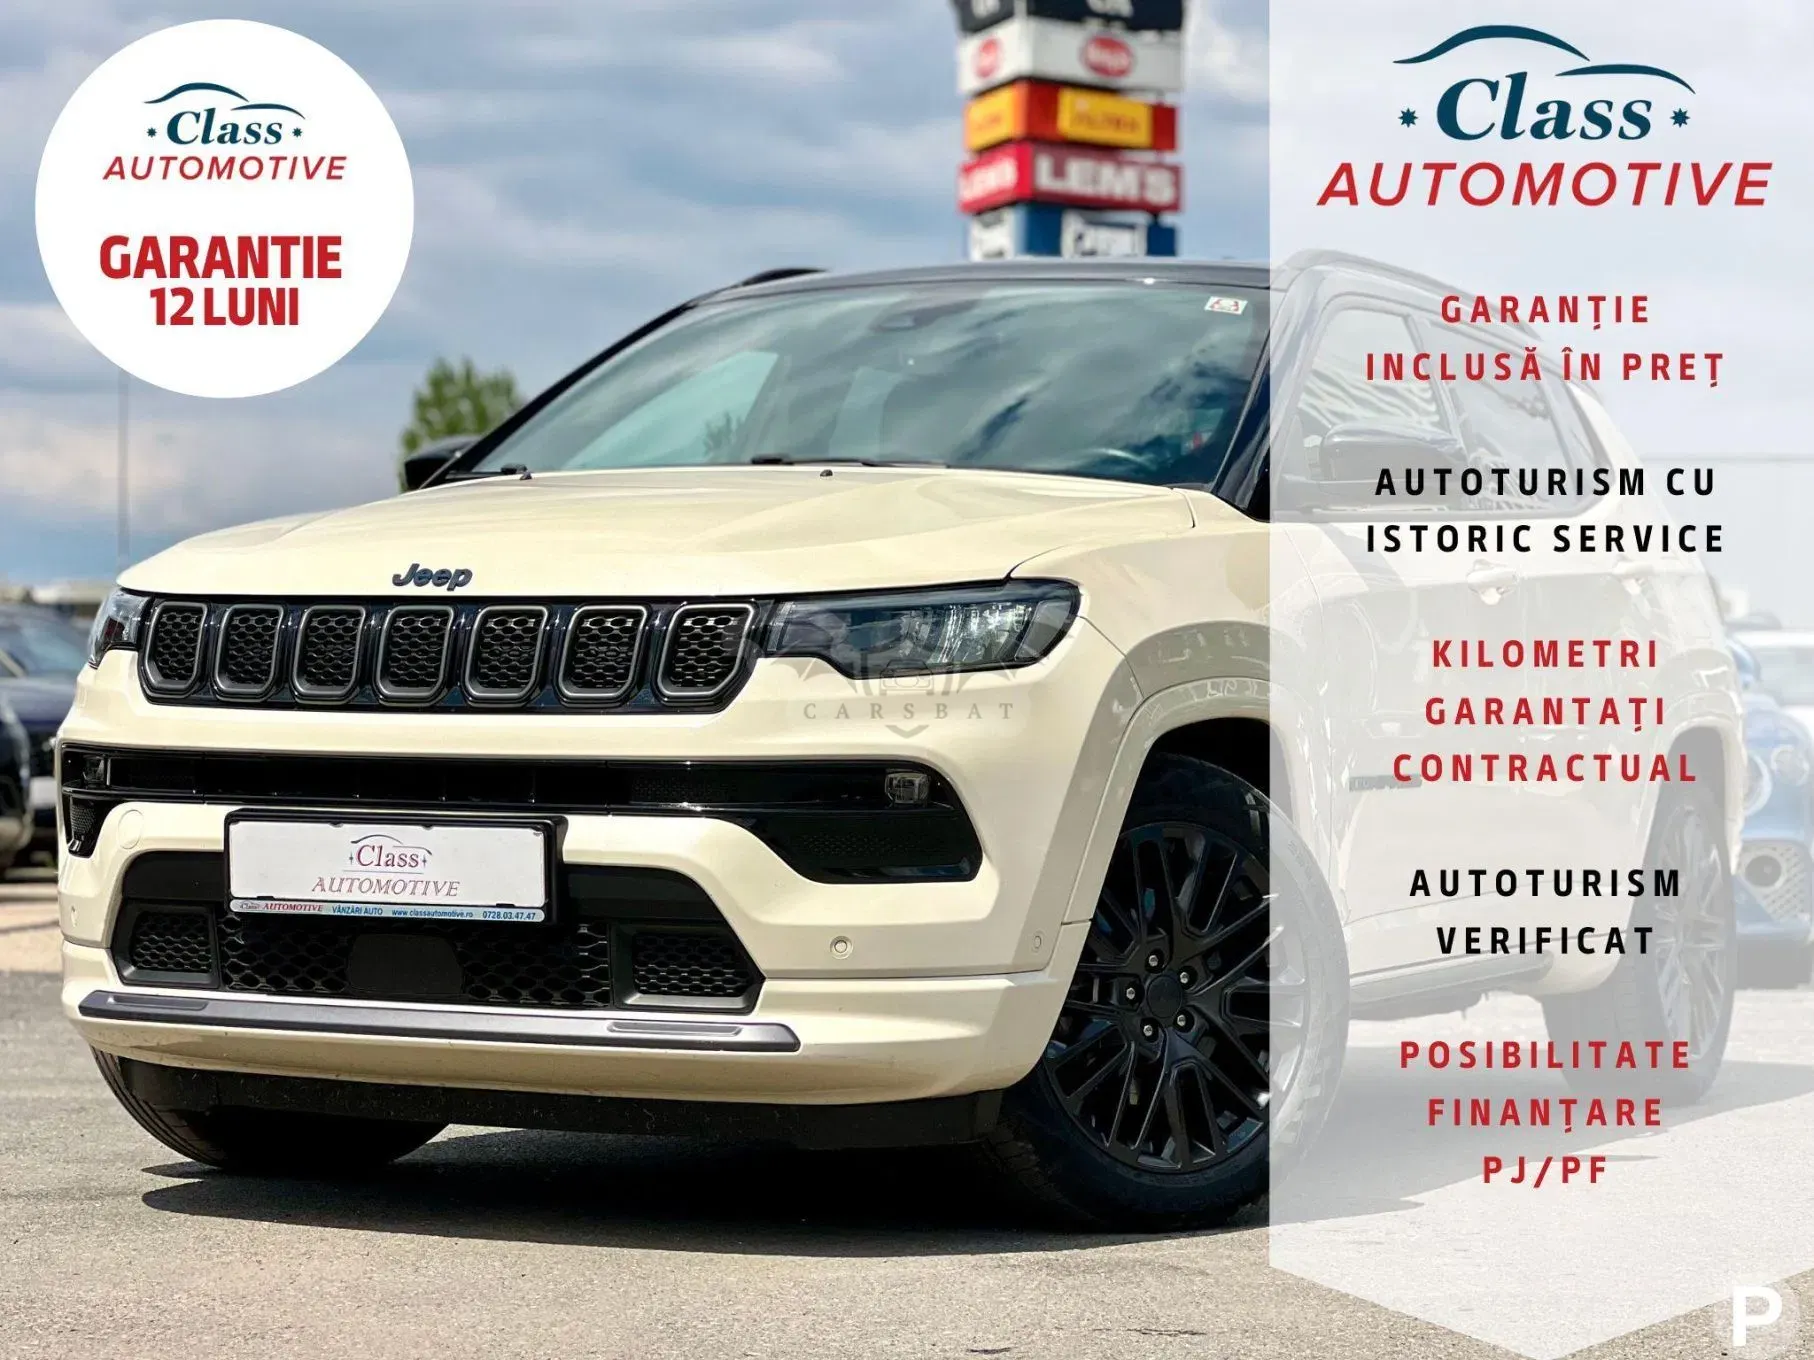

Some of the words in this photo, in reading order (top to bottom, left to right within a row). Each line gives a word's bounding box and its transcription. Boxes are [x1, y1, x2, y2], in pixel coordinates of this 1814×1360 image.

[392, 563, 473, 591] Jeep
[355, 844, 419, 869] Class
[311, 875, 460, 897] AUTOMOTIVE
[263, 902, 325, 912] AUTOMOTIVE
[363, 907, 384, 916] AUTO
[391, 908, 474, 918] www.classautomotive.ro
[482, 910, 536, 921] 0728.03.47.47
